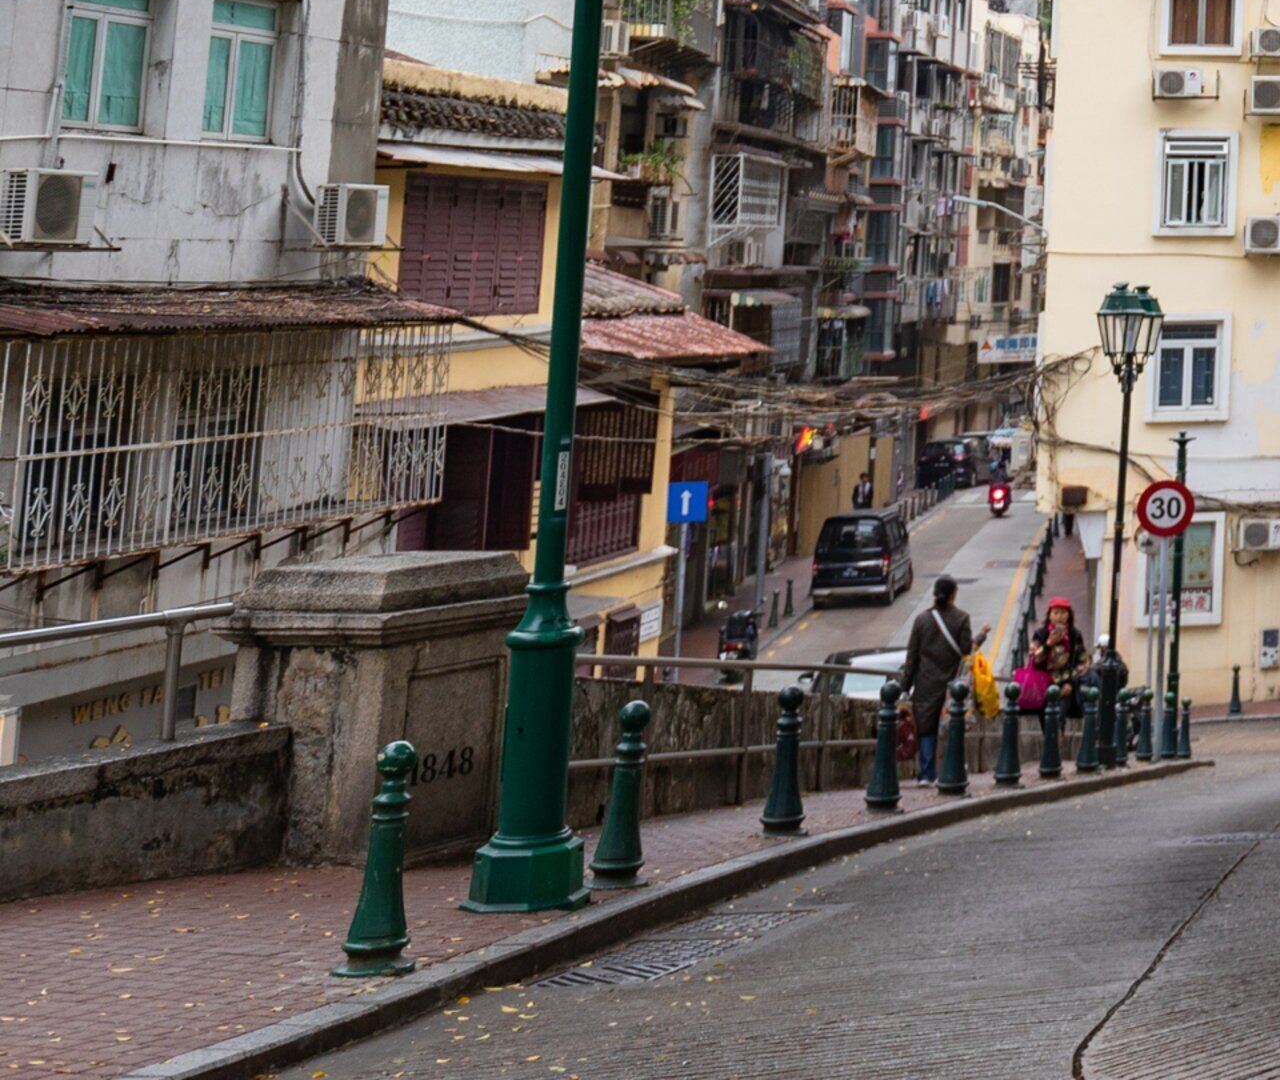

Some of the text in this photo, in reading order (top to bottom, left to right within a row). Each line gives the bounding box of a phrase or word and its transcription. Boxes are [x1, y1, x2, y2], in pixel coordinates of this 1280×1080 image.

[1150, 496, 1181, 519] 30
[73, 691, 130, 725] WENG
[411, 746, 474, 786] 1848
